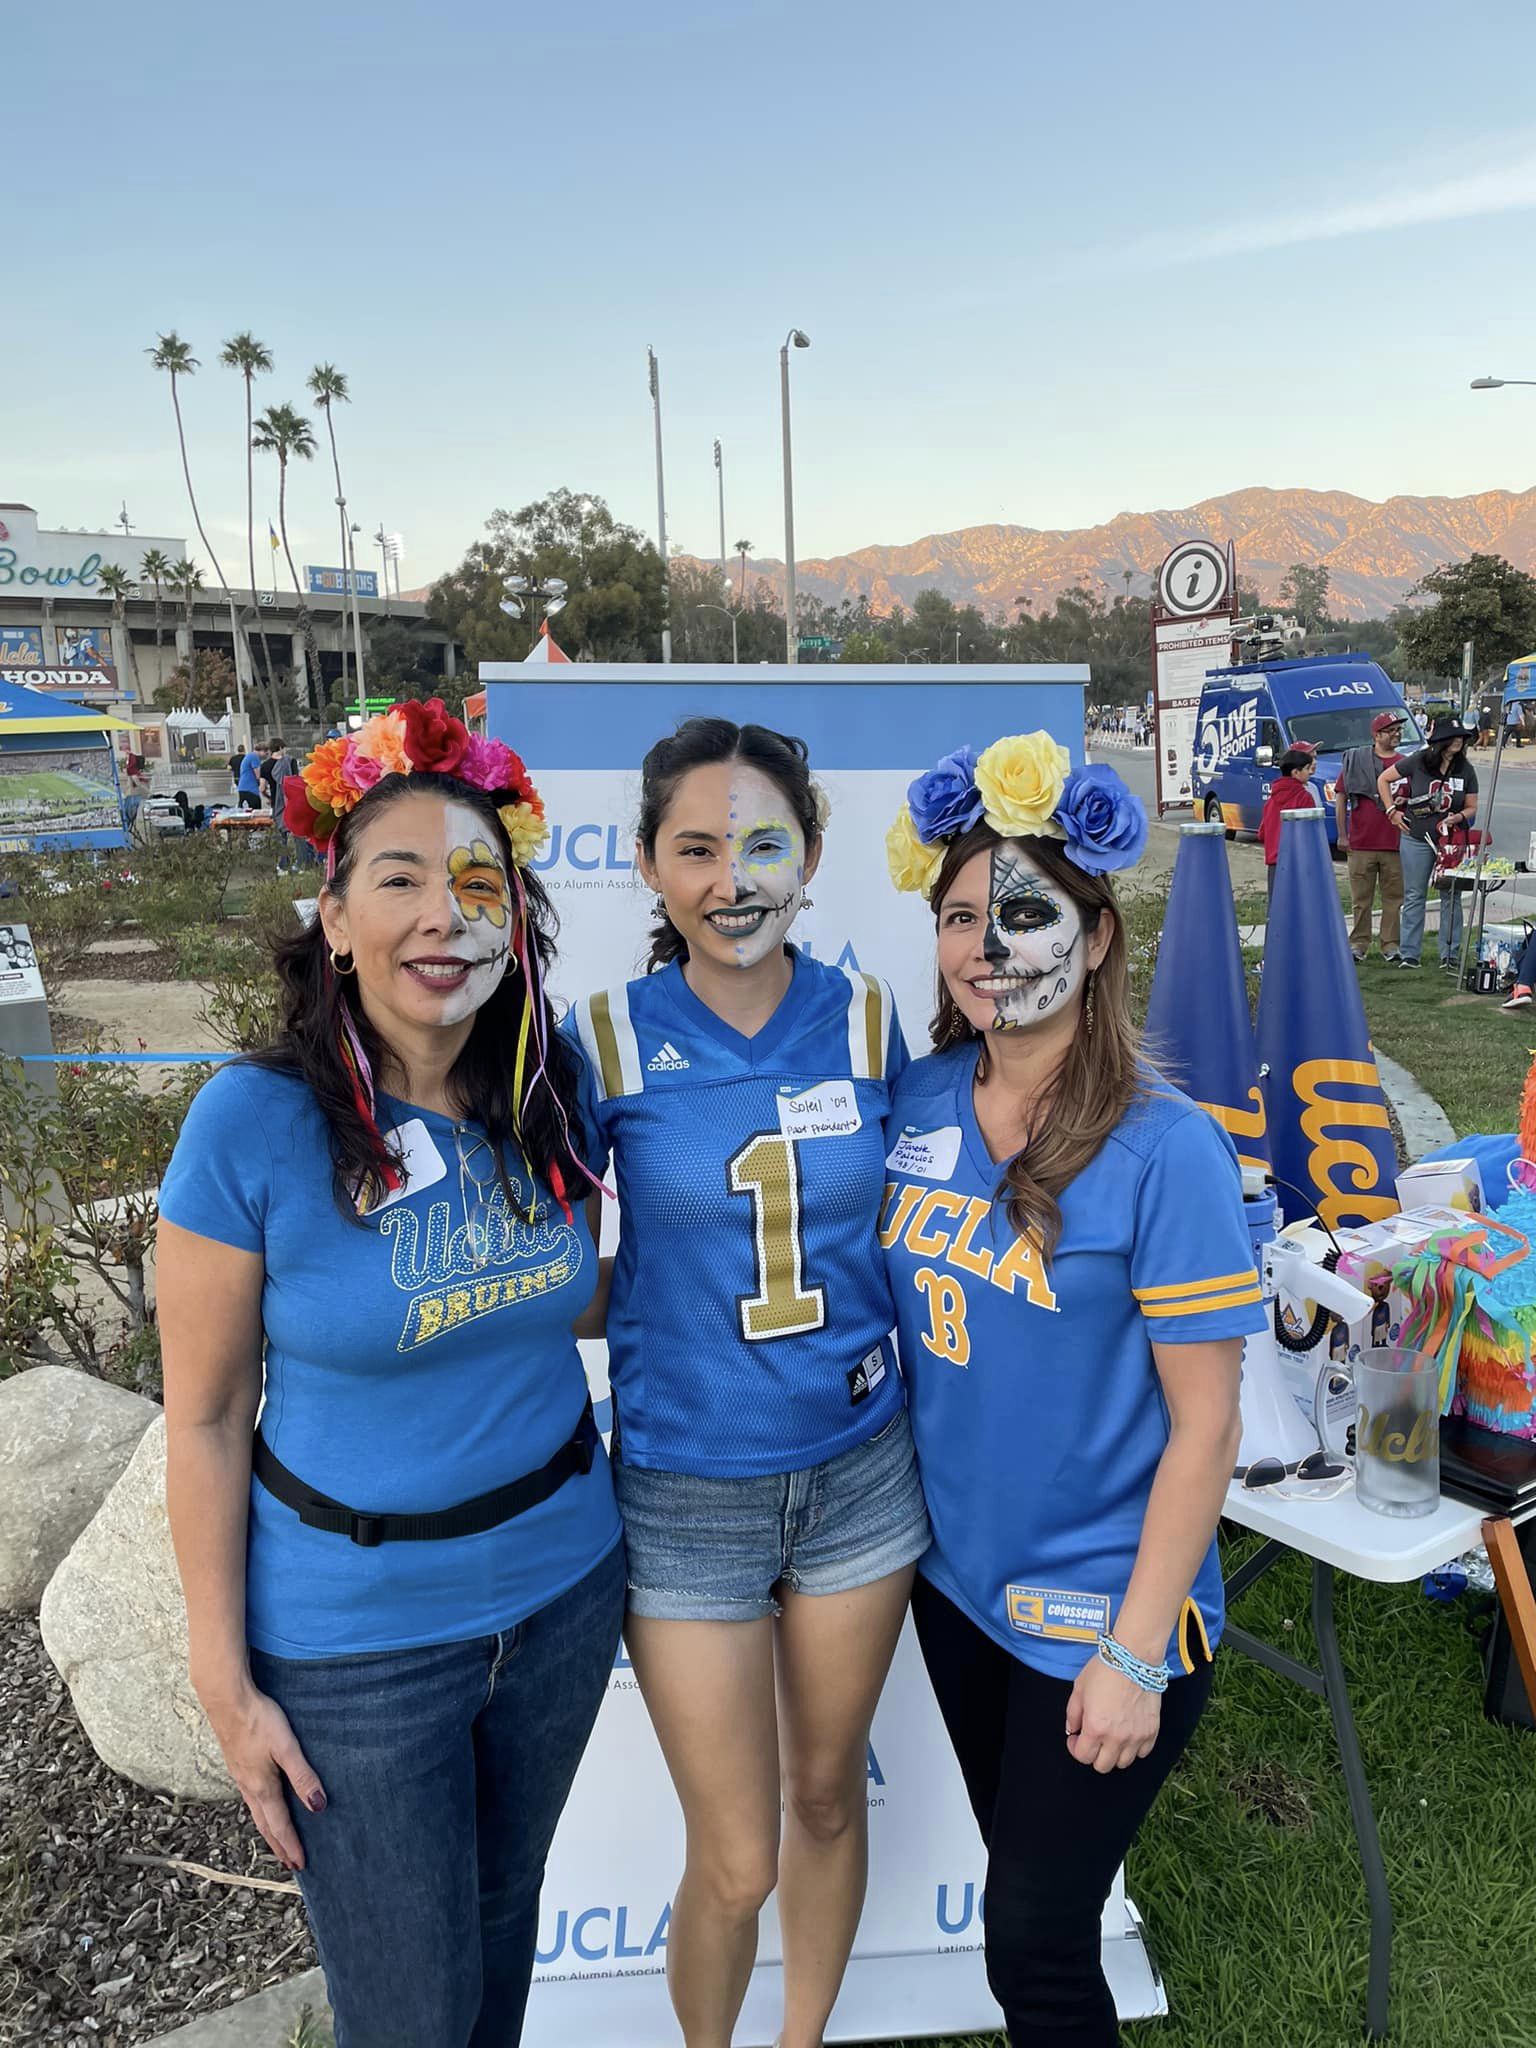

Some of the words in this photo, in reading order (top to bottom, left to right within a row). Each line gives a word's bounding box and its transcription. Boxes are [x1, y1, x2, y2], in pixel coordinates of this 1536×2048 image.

[1160, 638, 1204, 651] PROHIBITED
[1205, 635, 1229, 646] ITEMS
[1, 670, 111, 685] HONDA
[1220, 697, 1258, 744] LIVE
[1220, 729, 1257, 762] SPORTS
[529, 824, 640, 871] UCL
[564, 880, 604, 889] Alumni
[647, 1058, 690, 1072] adidas
[728, 1131, 825, 1342] 1
[878, 1182, 1056, 1311] UCLA
[414, 1263, 571, 1342] BRUINS
[1047, 1603, 1105, 1621] colosseum
[937, 1944, 974, 1954] Latino
[533, 1975, 566, 1983] atino
[570, 1970, 612, 1981] Alumni
[615, 1967, 666, 1978] Associat
